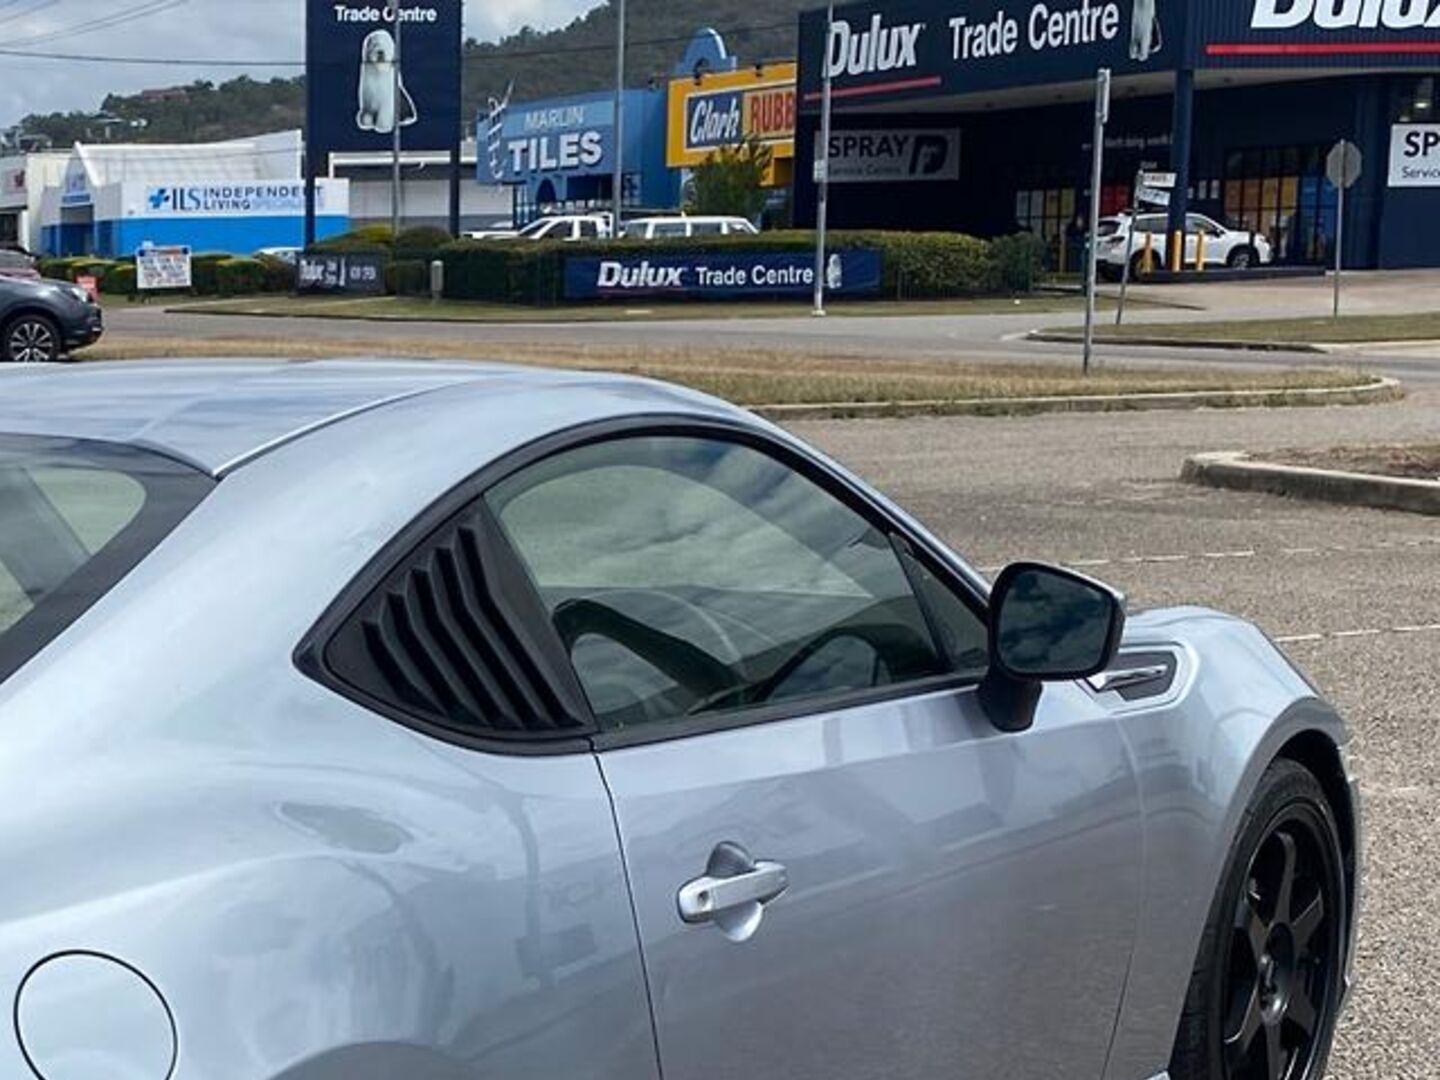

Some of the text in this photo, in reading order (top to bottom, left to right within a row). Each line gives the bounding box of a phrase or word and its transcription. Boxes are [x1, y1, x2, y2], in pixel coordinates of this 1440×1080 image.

[334, 6, 380, 21] Trade
[822, 0, 1119, 78] Dulux Trade Centre
[524, 106, 585, 130] MARLIN
[690, 98, 740, 144] Clark
[508, 131, 602, 172] TILES
[828, 135, 909, 158] SPRAY
[172, 187, 200, 211] ILS
[203, 185, 324, 199] INDEPENDET
[203, 199, 251, 210] LIVING
[597, 261, 814, 287] Dulux Trade Centre
